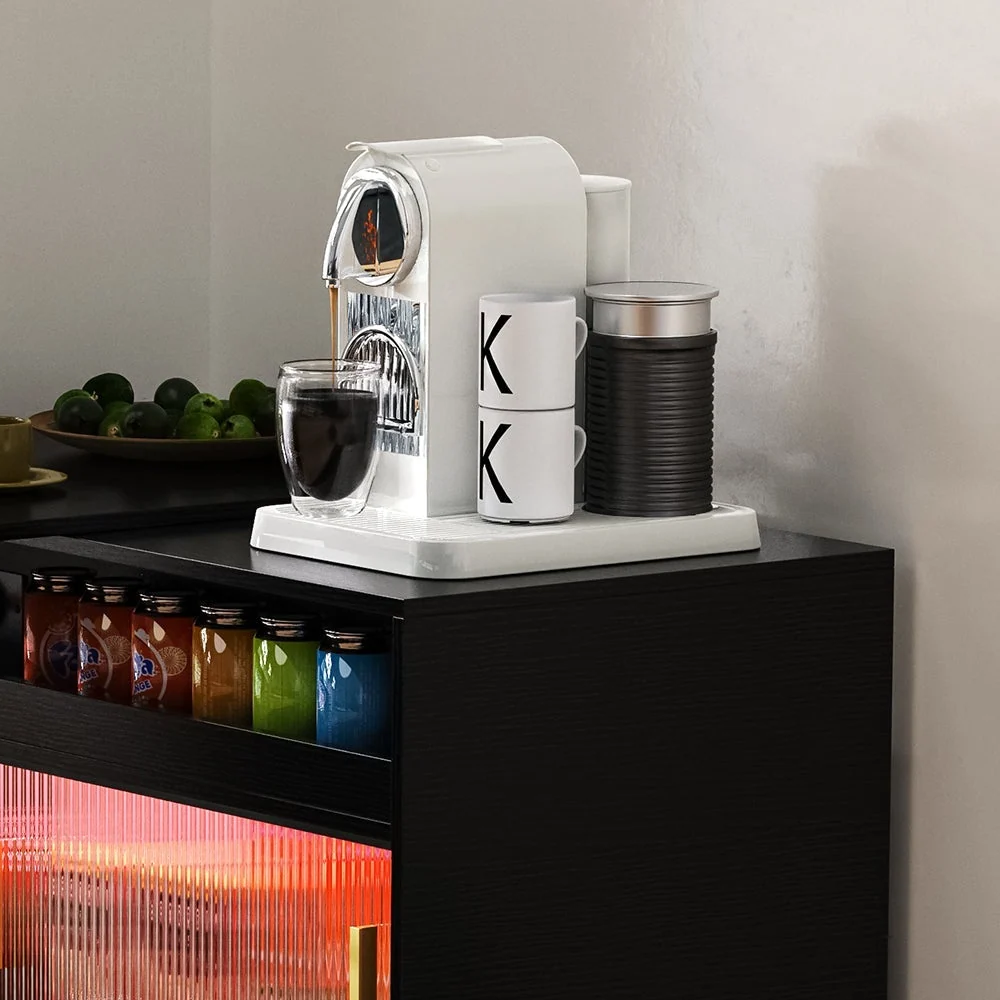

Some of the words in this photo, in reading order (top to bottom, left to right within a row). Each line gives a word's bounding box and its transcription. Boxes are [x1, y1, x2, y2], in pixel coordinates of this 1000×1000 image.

[480, 311, 513, 395] K
[480, 420, 513, 504] K
[80, 669, 98, 683] NGE
[133, 679, 152, 697] NGE
